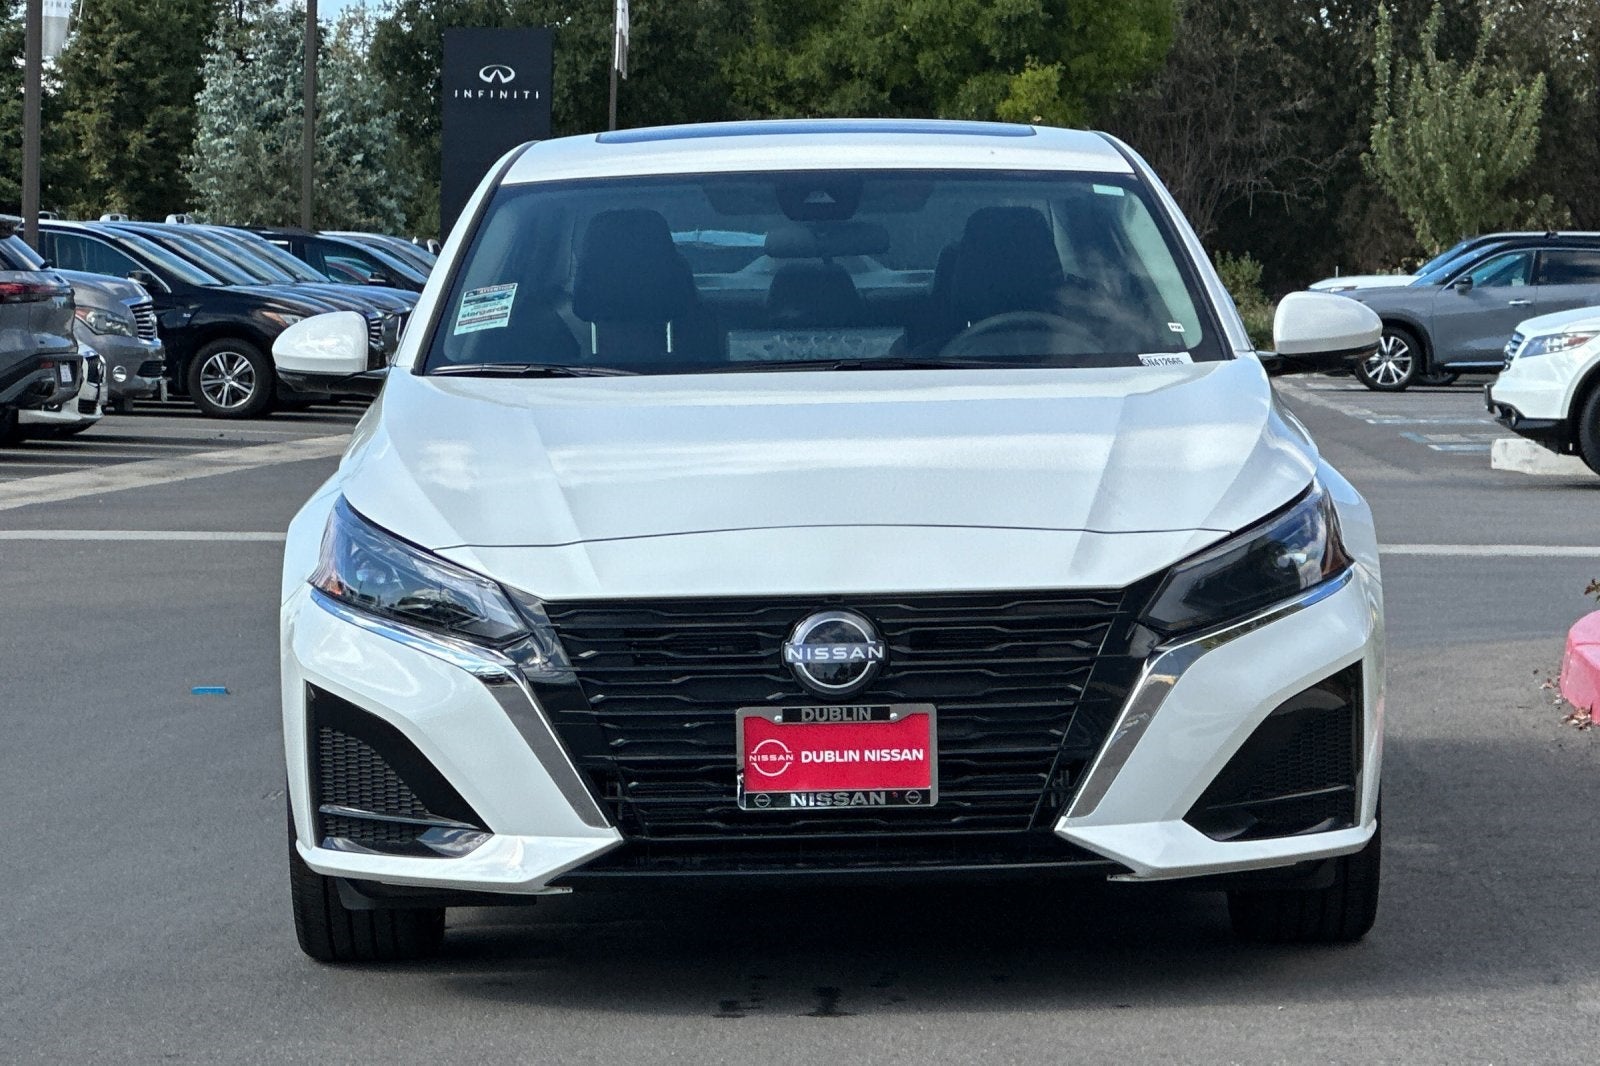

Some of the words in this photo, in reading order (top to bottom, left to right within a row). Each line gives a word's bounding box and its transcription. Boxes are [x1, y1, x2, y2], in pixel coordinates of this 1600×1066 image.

[454, 89, 539, 99] INFINITI
[787, 646, 883, 660] NISSAN
[801, 707, 872, 721] DUBLIN
[749, 754, 794, 762] NISSAN
[801, 750, 860, 763] DUBLIN
[864, 748, 924, 762] NISSAN
[790, 791, 886, 807] NISSAN
